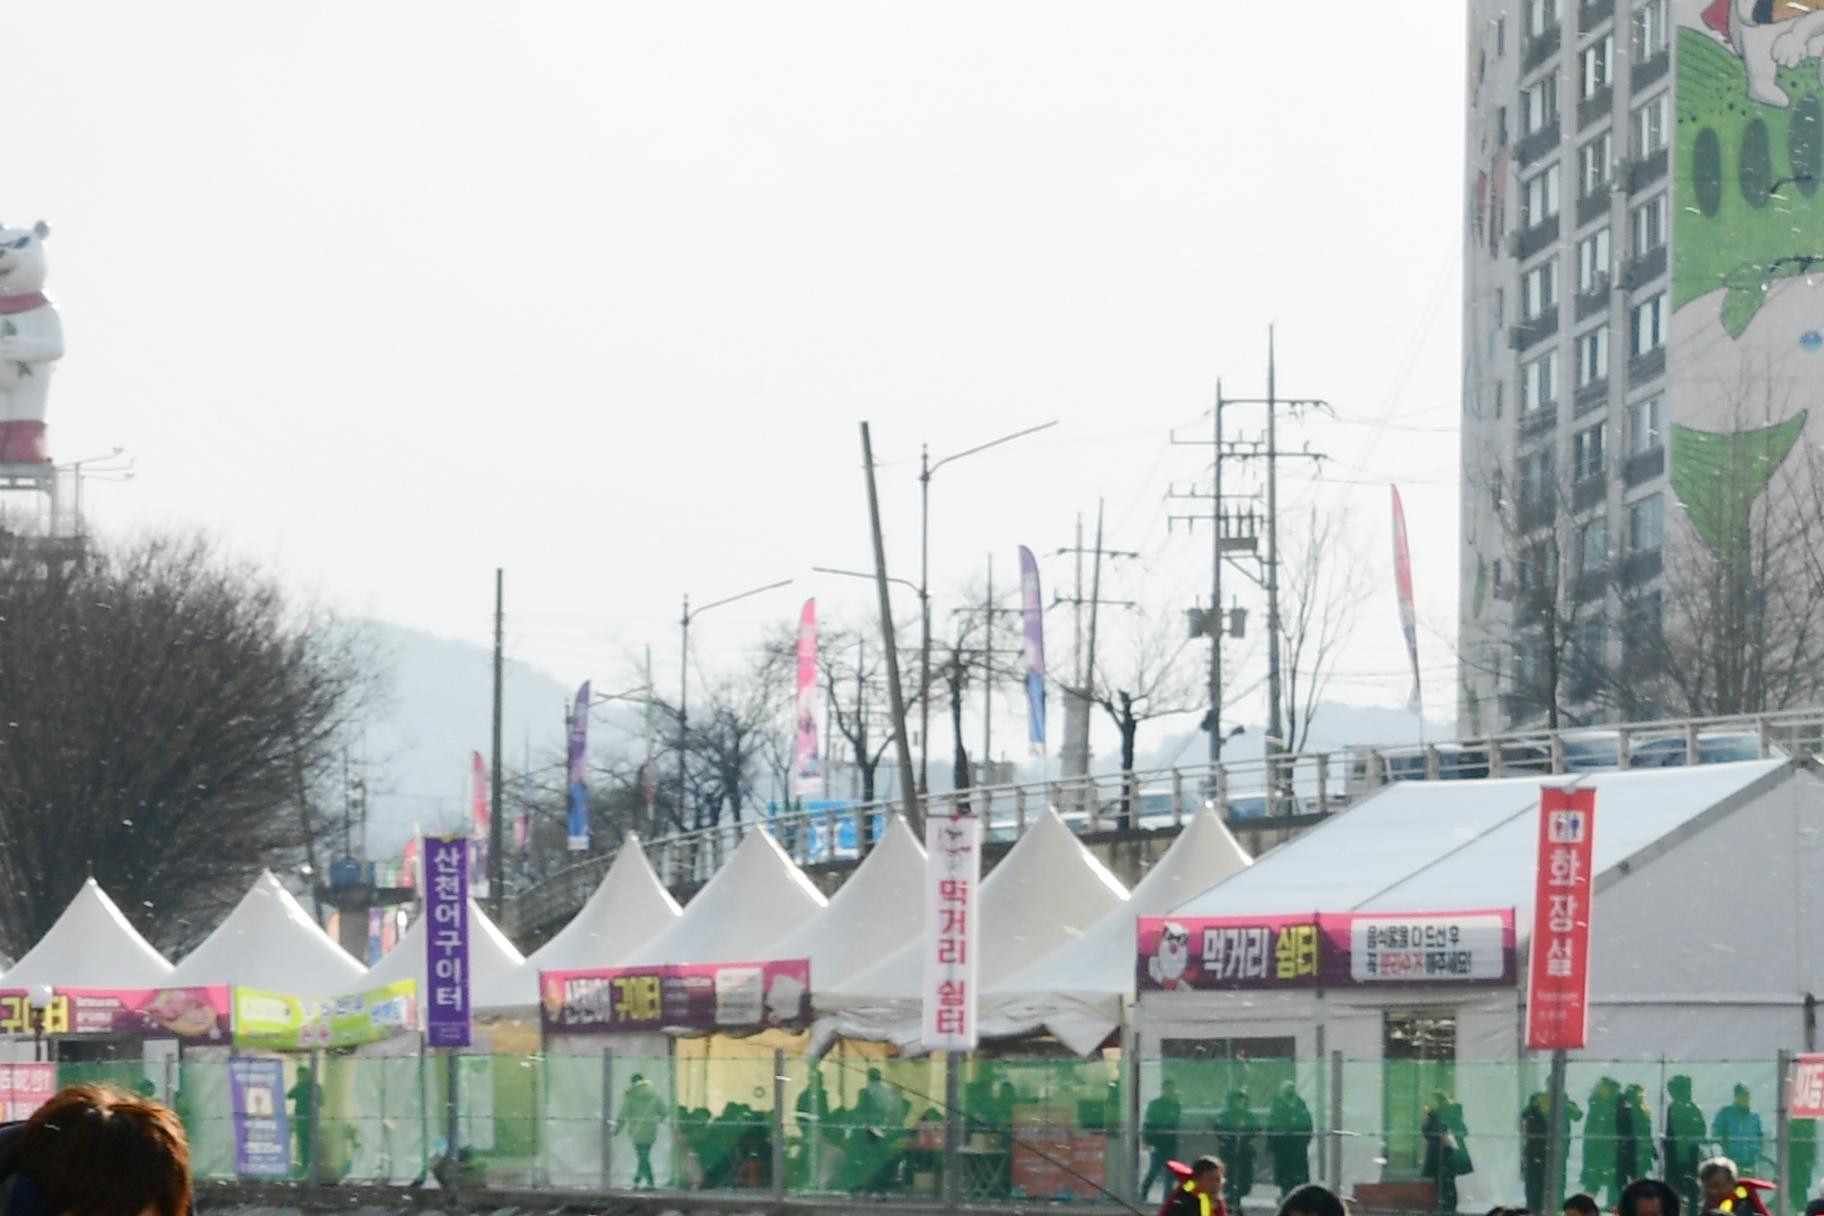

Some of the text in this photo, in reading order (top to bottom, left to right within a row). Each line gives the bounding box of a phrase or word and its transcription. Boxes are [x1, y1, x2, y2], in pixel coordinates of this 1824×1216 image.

[434, 847, 463, 1011] 산천어구이터
[936, 879, 968, 1035] 먹거리 쉼터
[1202, 924, 1318, 980] 먹거리 쉼터
[1425, 925, 1447, 948] 드신
[1449, 925, 1460, 949] 후
[1548, 848, 1581, 977] 화장실
